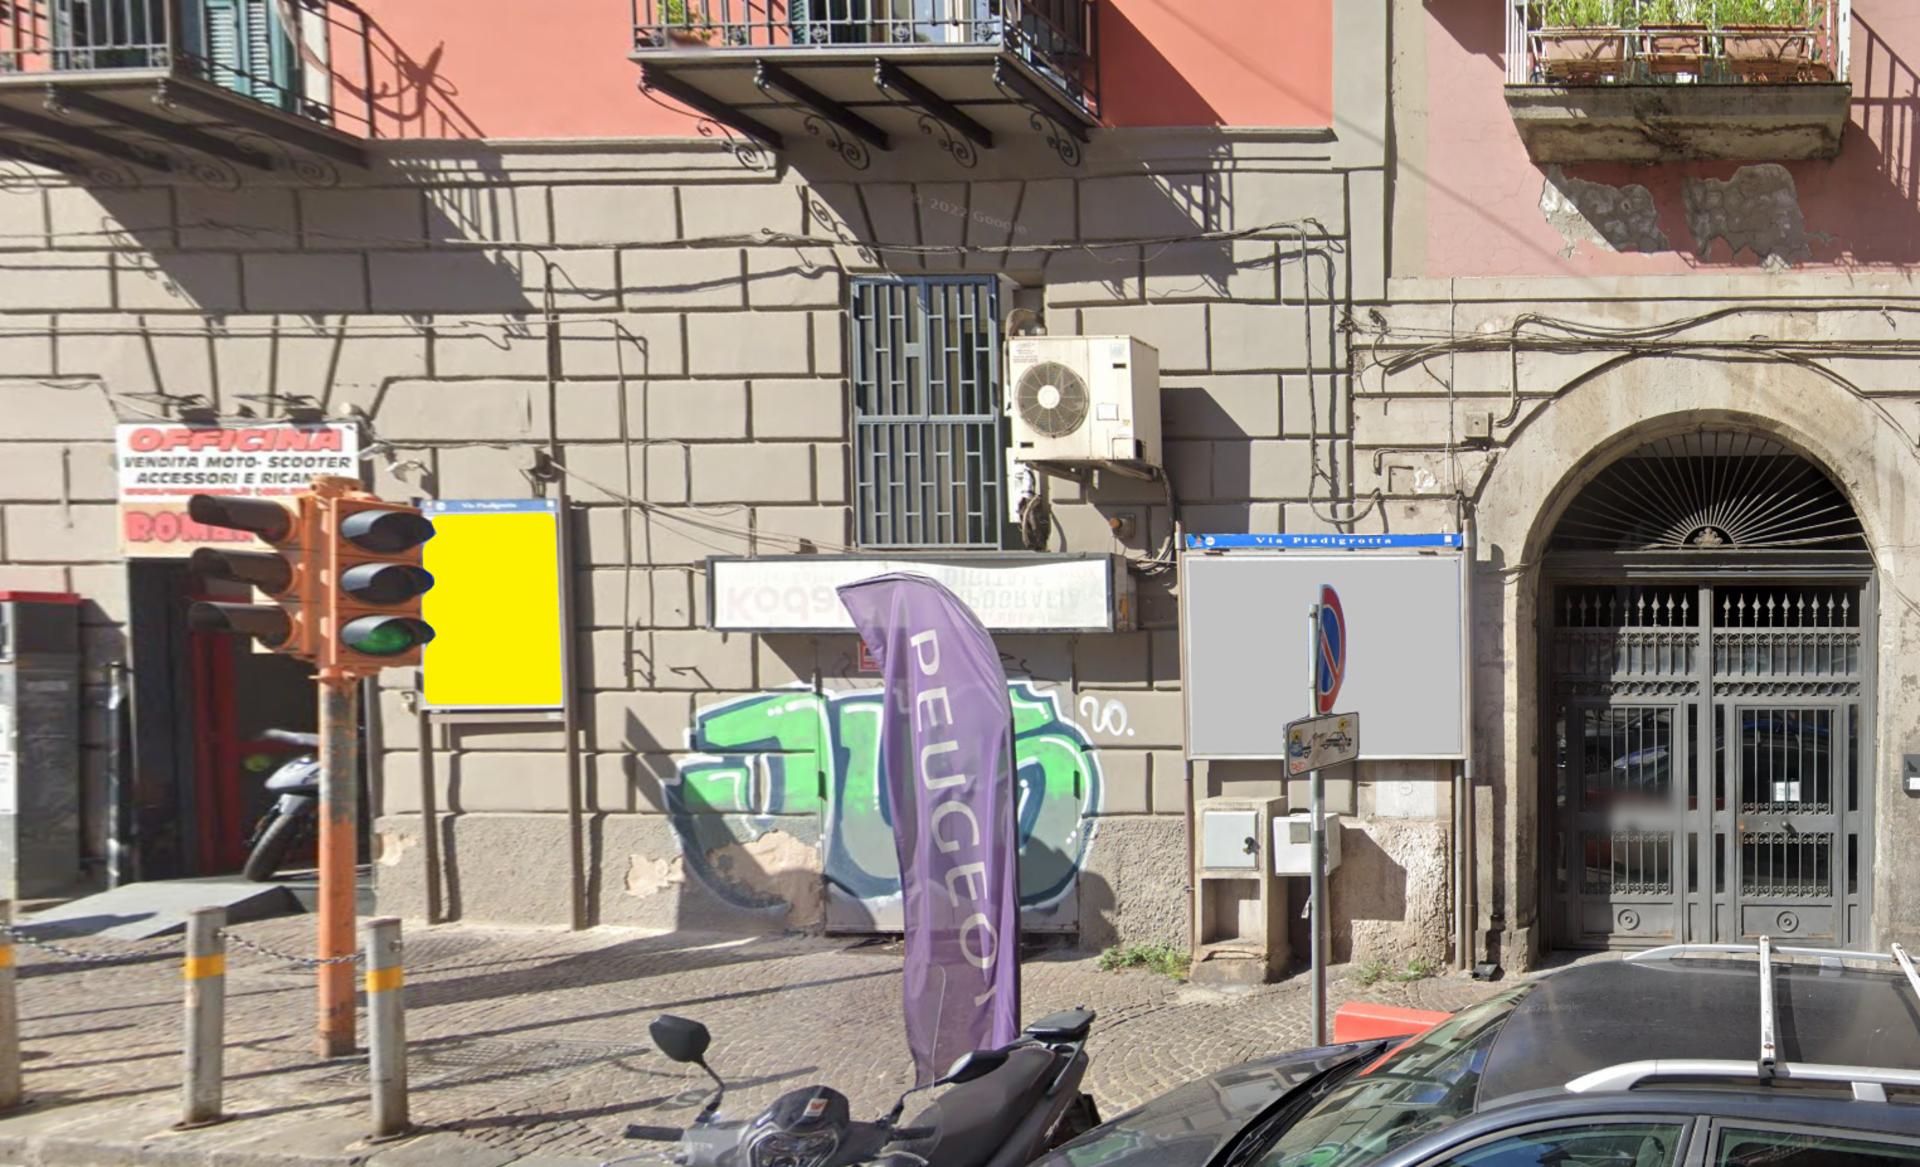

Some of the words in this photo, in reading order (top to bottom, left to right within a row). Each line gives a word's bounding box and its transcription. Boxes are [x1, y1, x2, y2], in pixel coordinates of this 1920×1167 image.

[129, 427, 343, 452] OFFICINA
[124, 456, 199, 468] VENDITA
[268, 456, 351, 468] SCOOTER
[136, 472, 238, 485] ACCESSORI
[243, 472, 255, 484] E
[260, 472, 339, 484] RICA
[1256, 536, 1283, 544] Via
[1293, 536, 1392, 546] Piedigrotta
